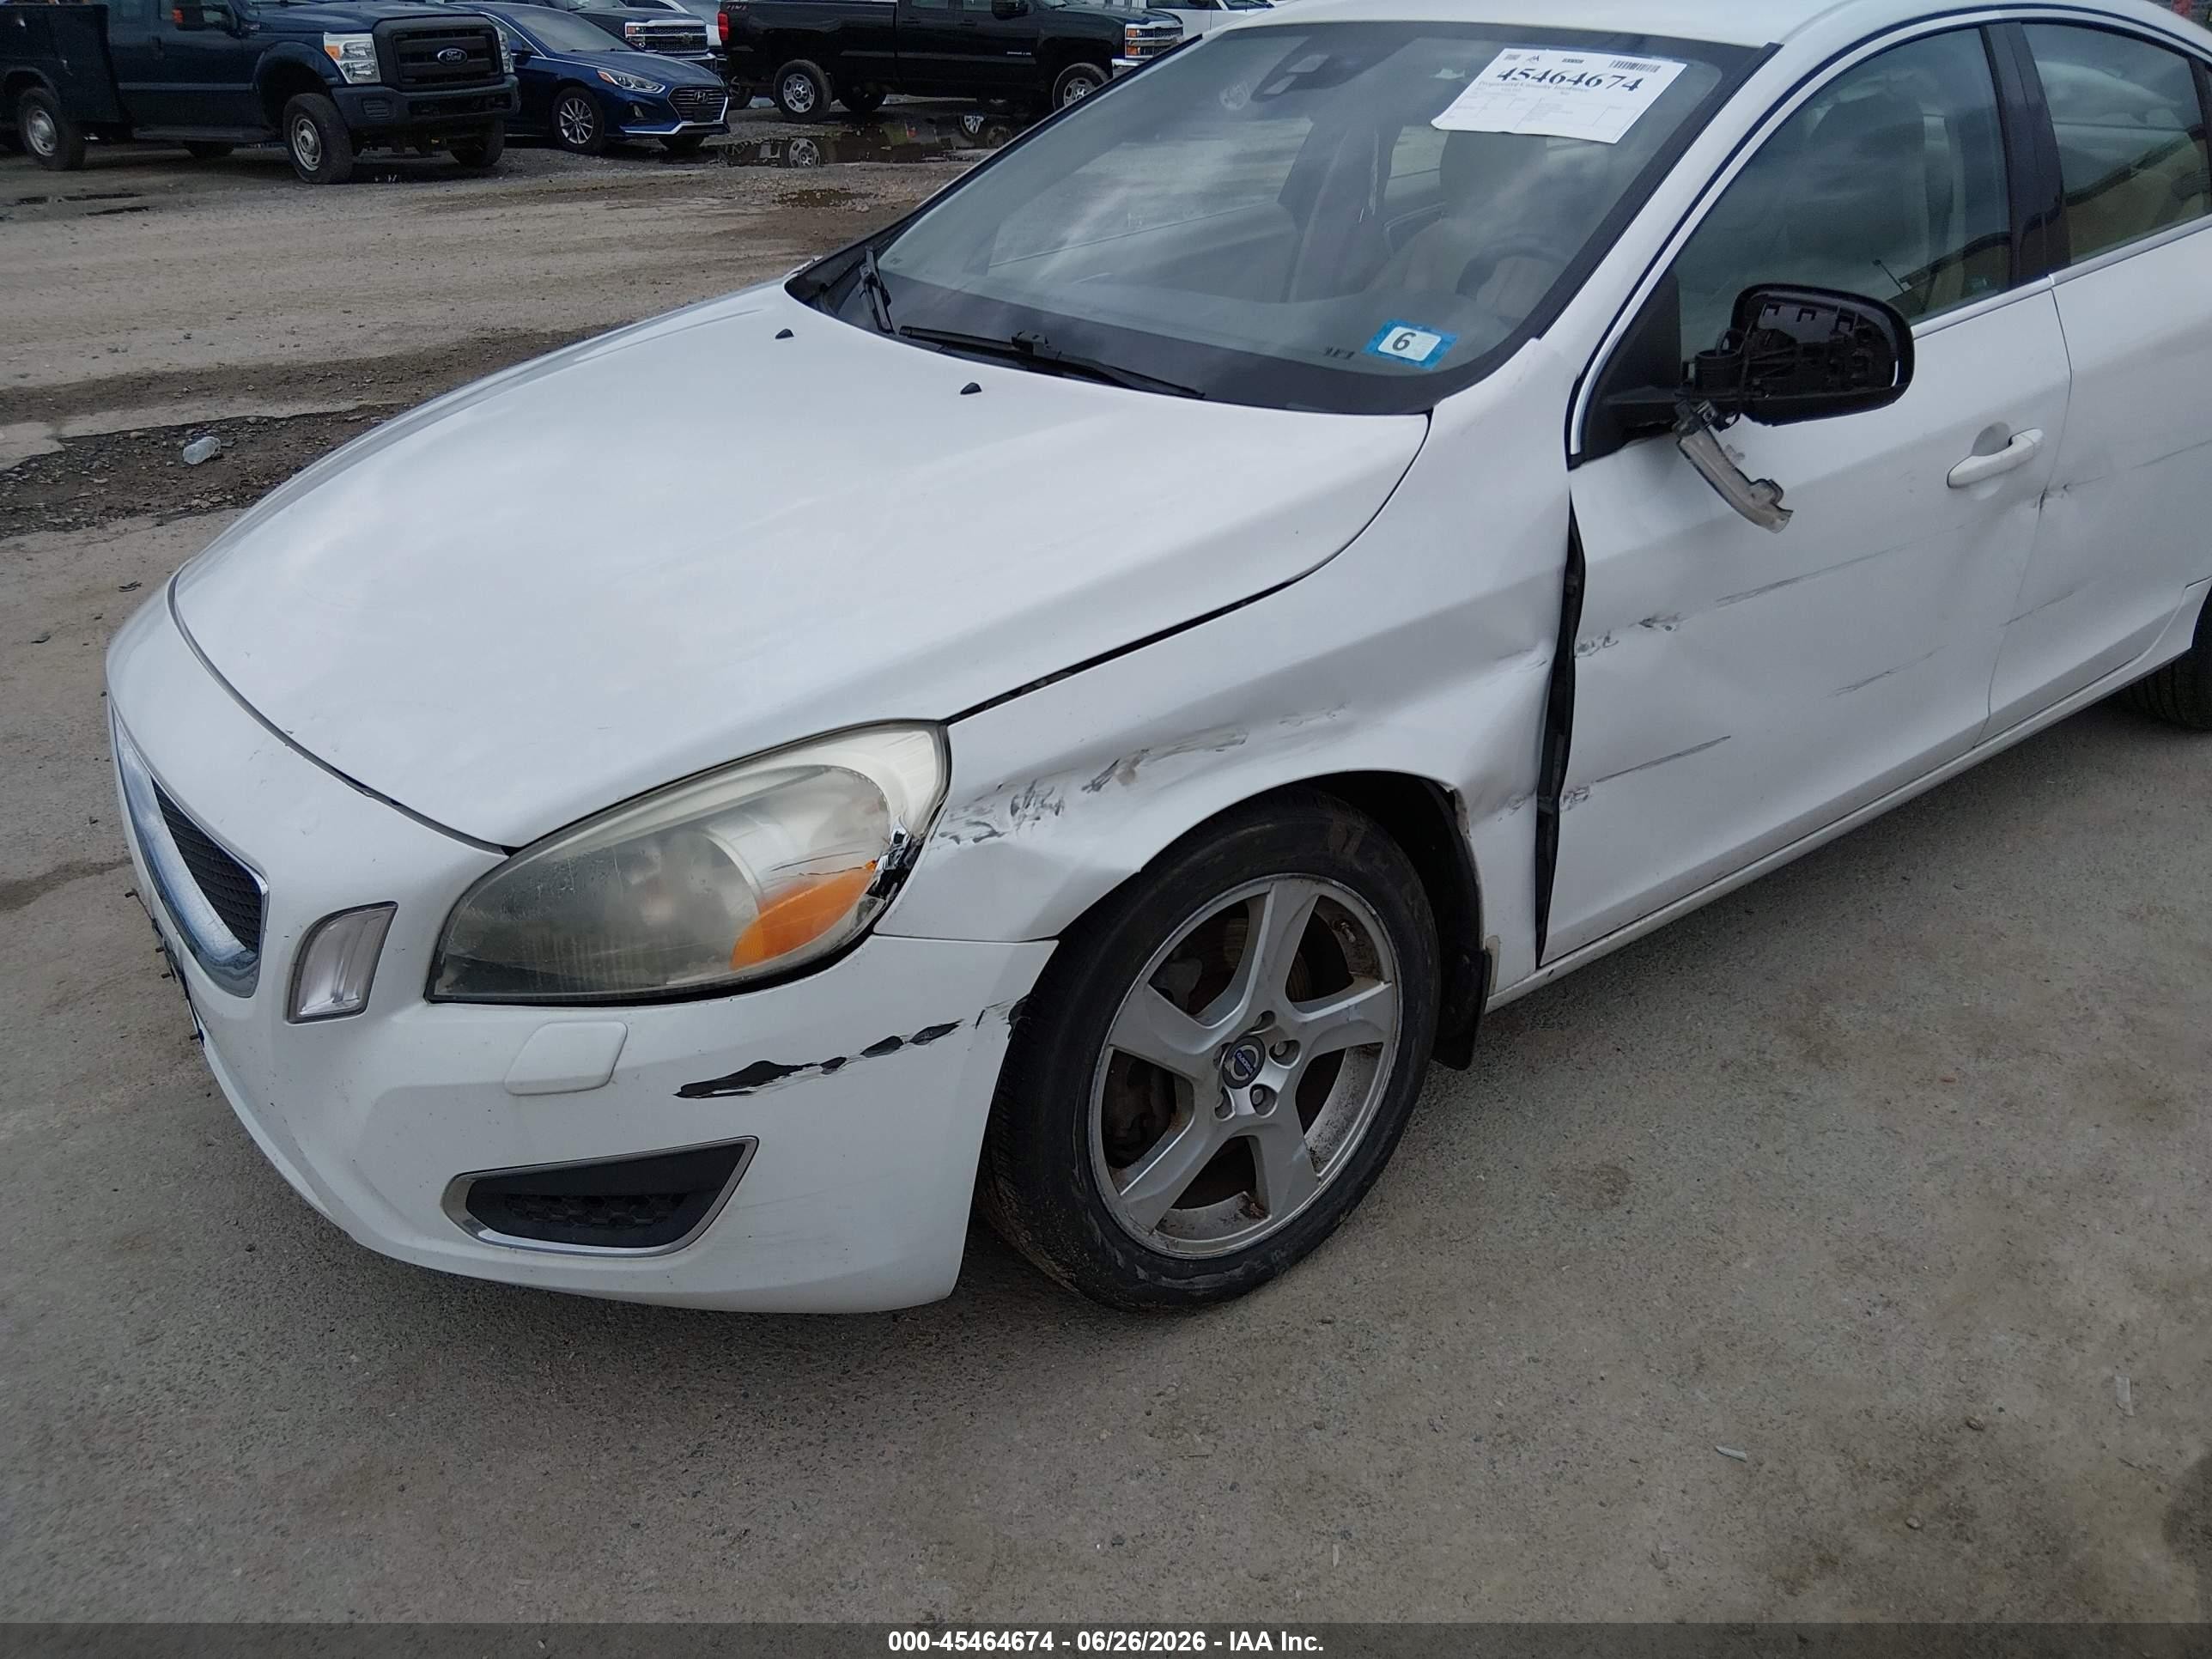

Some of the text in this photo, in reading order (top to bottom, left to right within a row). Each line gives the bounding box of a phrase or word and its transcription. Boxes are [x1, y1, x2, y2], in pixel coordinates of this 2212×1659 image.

[446, 51, 462, 62] Ford
[1497, 67, 1644, 92] 45464674
[1392, 331, 1417, 352] 6
